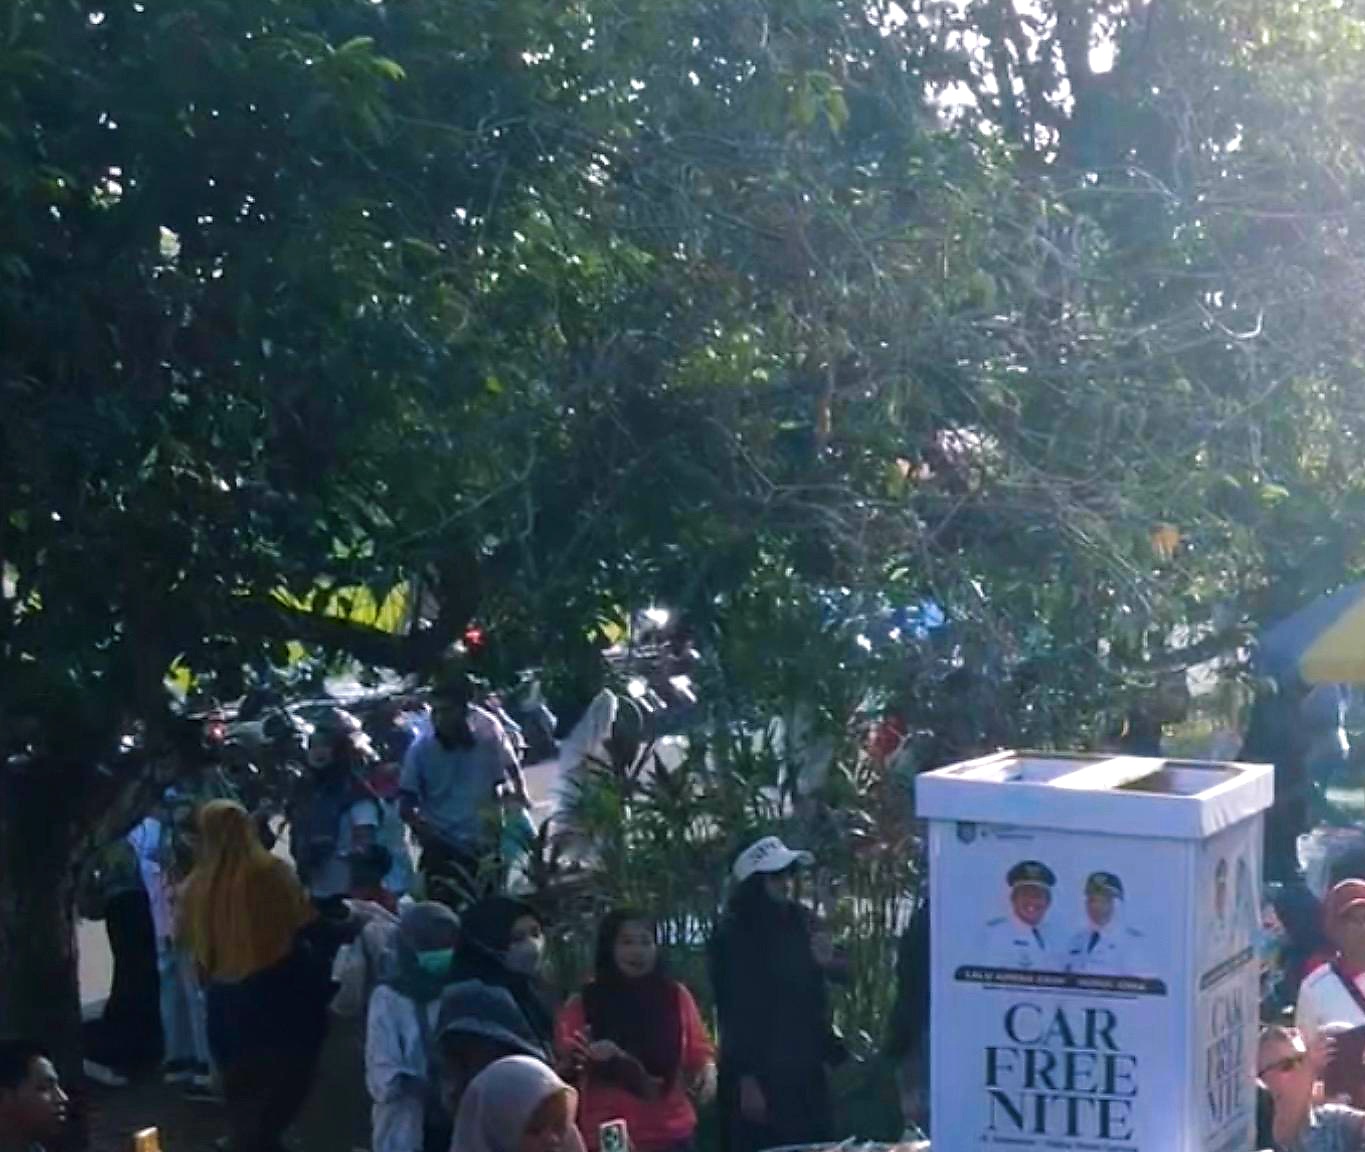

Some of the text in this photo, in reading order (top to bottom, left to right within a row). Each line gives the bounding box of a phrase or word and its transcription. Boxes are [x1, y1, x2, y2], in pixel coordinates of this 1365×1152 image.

[1004, 1002, 1119, 1050] CAR
[985, 1047, 1138, 1096] FREE
[989, 1090, 1135, 1141] NITE
